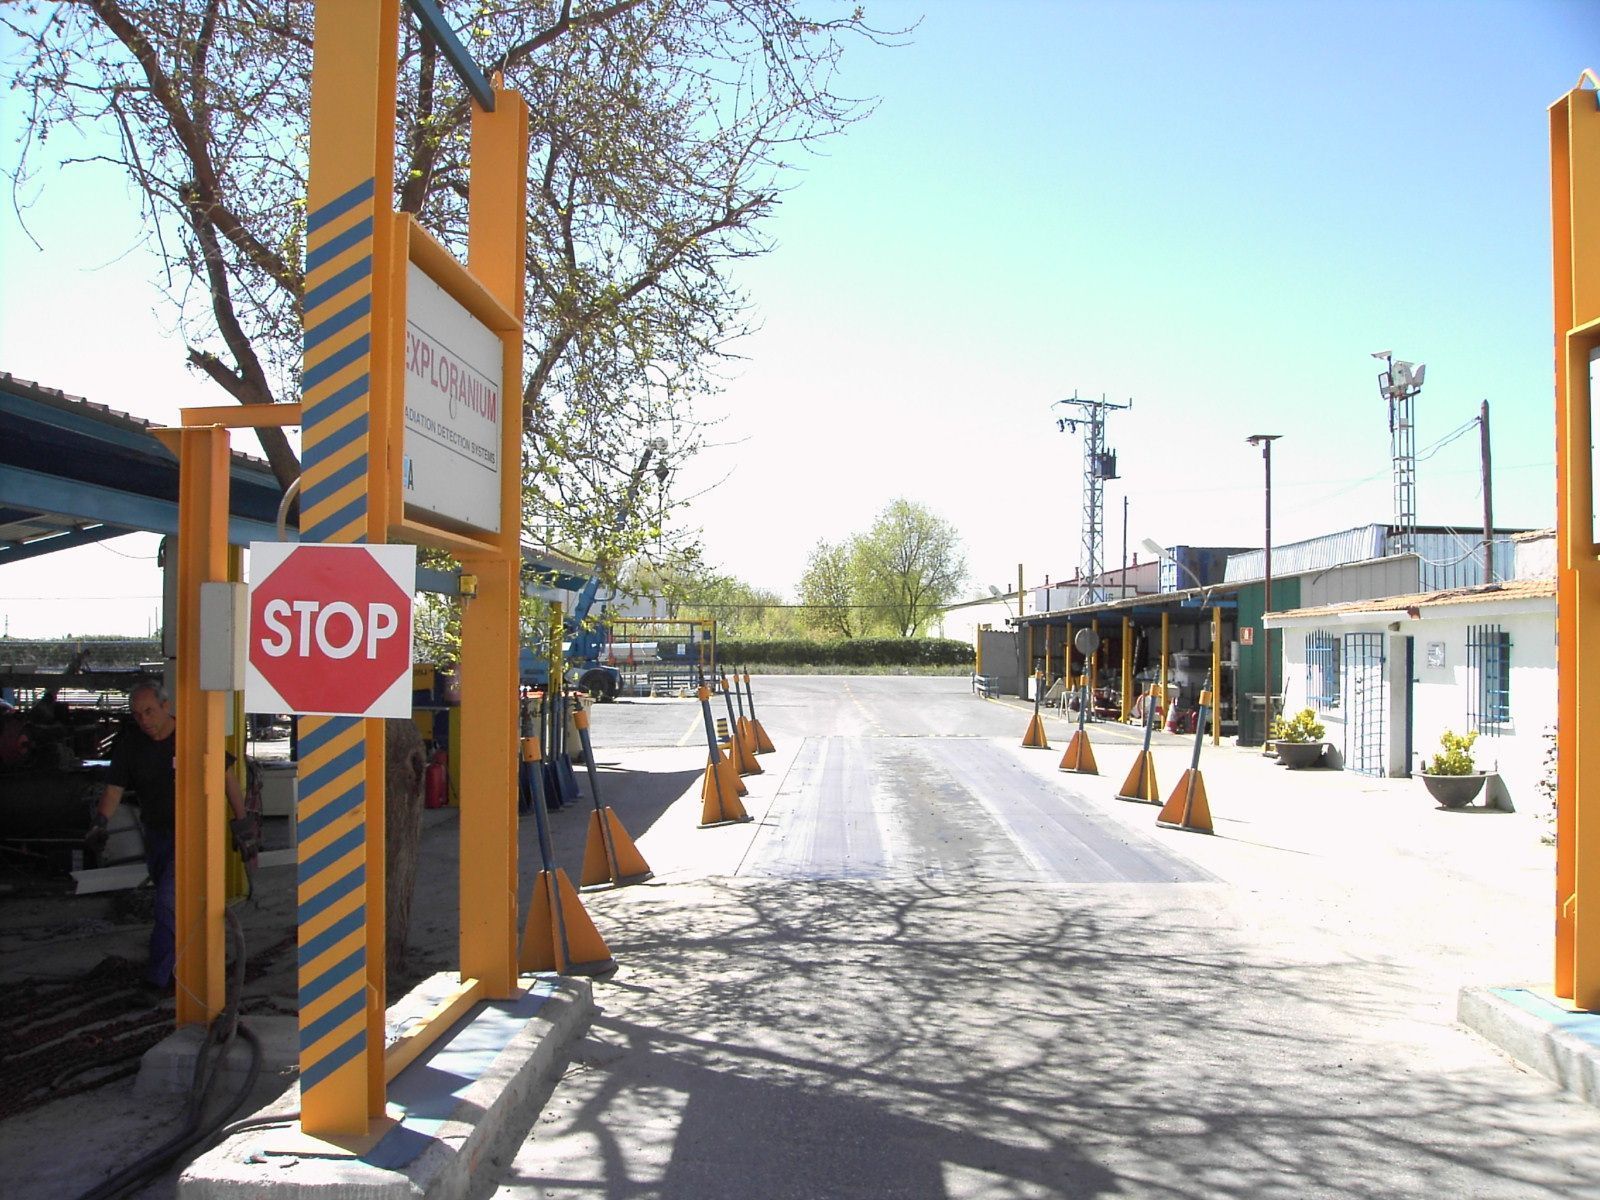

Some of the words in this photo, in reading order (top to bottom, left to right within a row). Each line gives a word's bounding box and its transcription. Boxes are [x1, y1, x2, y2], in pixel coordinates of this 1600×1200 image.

[437, 423, 470, 450] DETECTION
[471, 442, 496, 464] SYSTEMS
[261, 599, 399, 660] STOP
